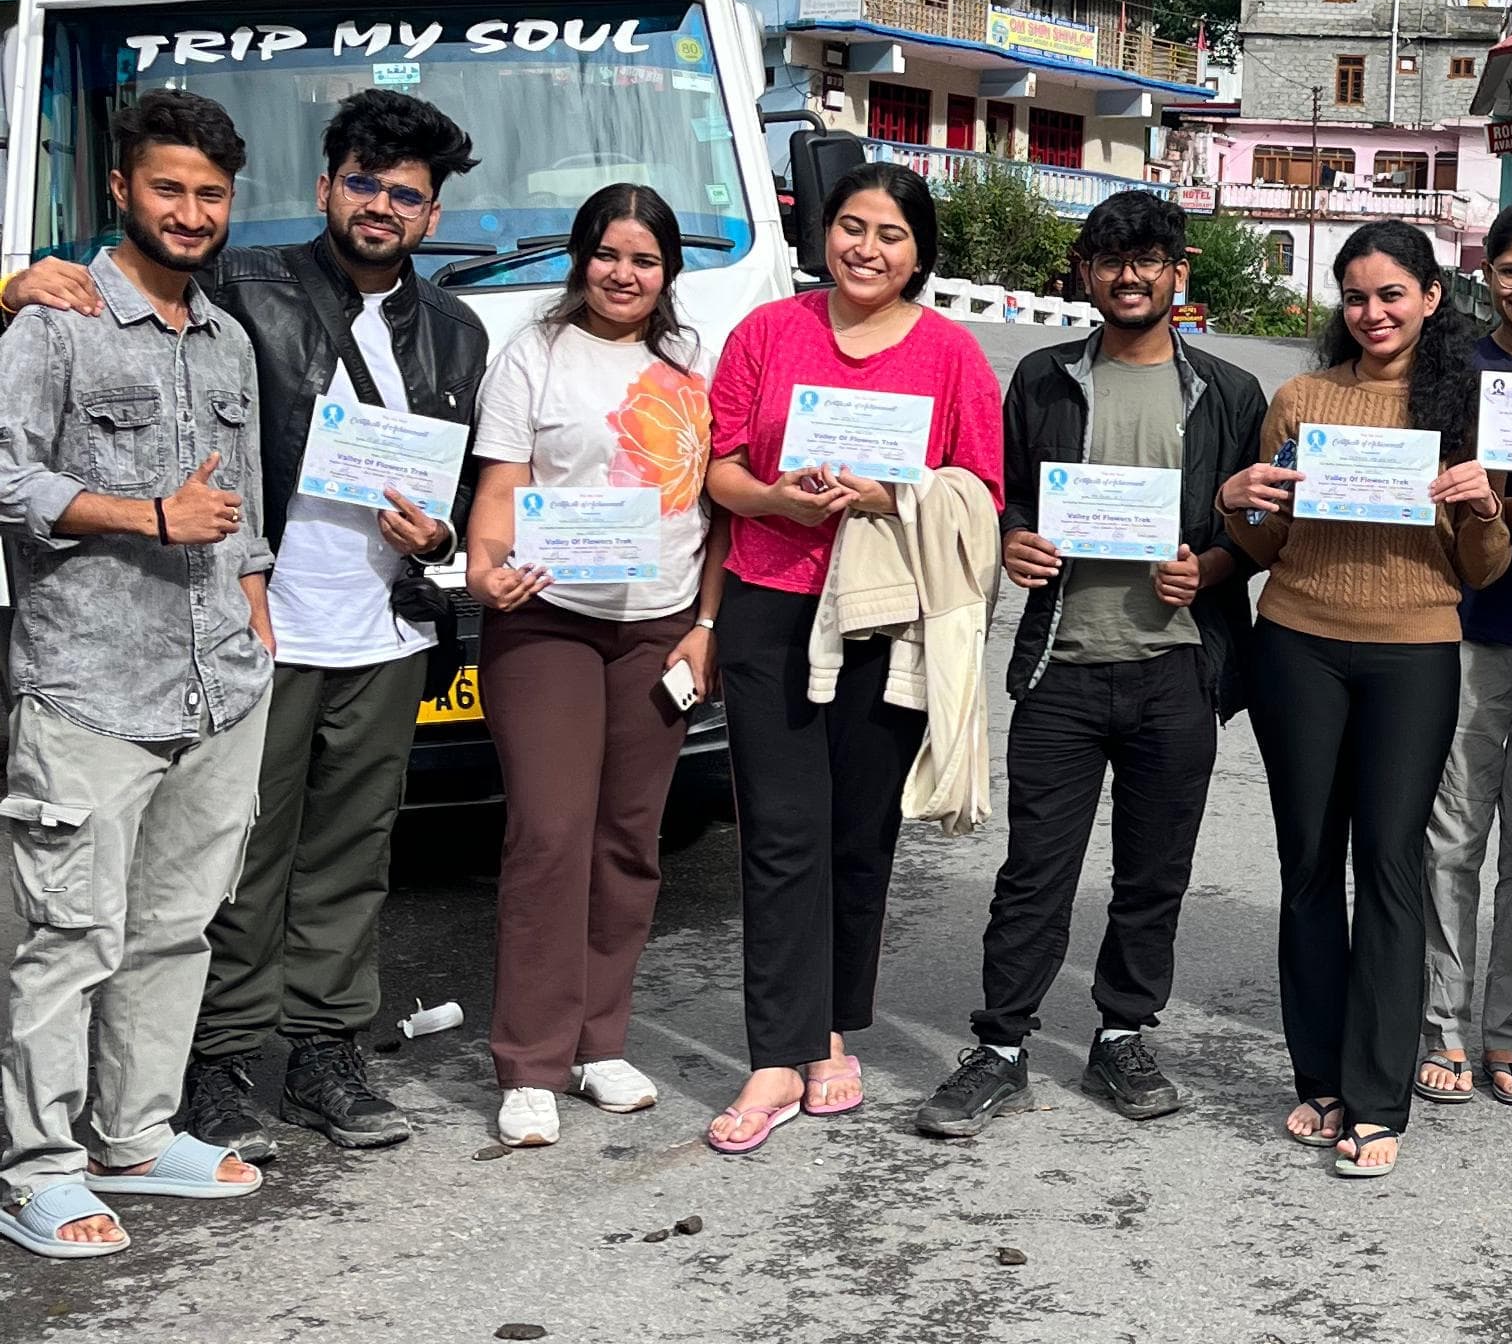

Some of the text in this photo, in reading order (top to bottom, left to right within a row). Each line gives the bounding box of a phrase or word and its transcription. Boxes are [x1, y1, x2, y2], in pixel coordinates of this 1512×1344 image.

[126, 19, 650, 72] TRIP MY SOUL
[681, 43, 698, 55] 80
[1182, 190, 1211, 200] HOTEL
